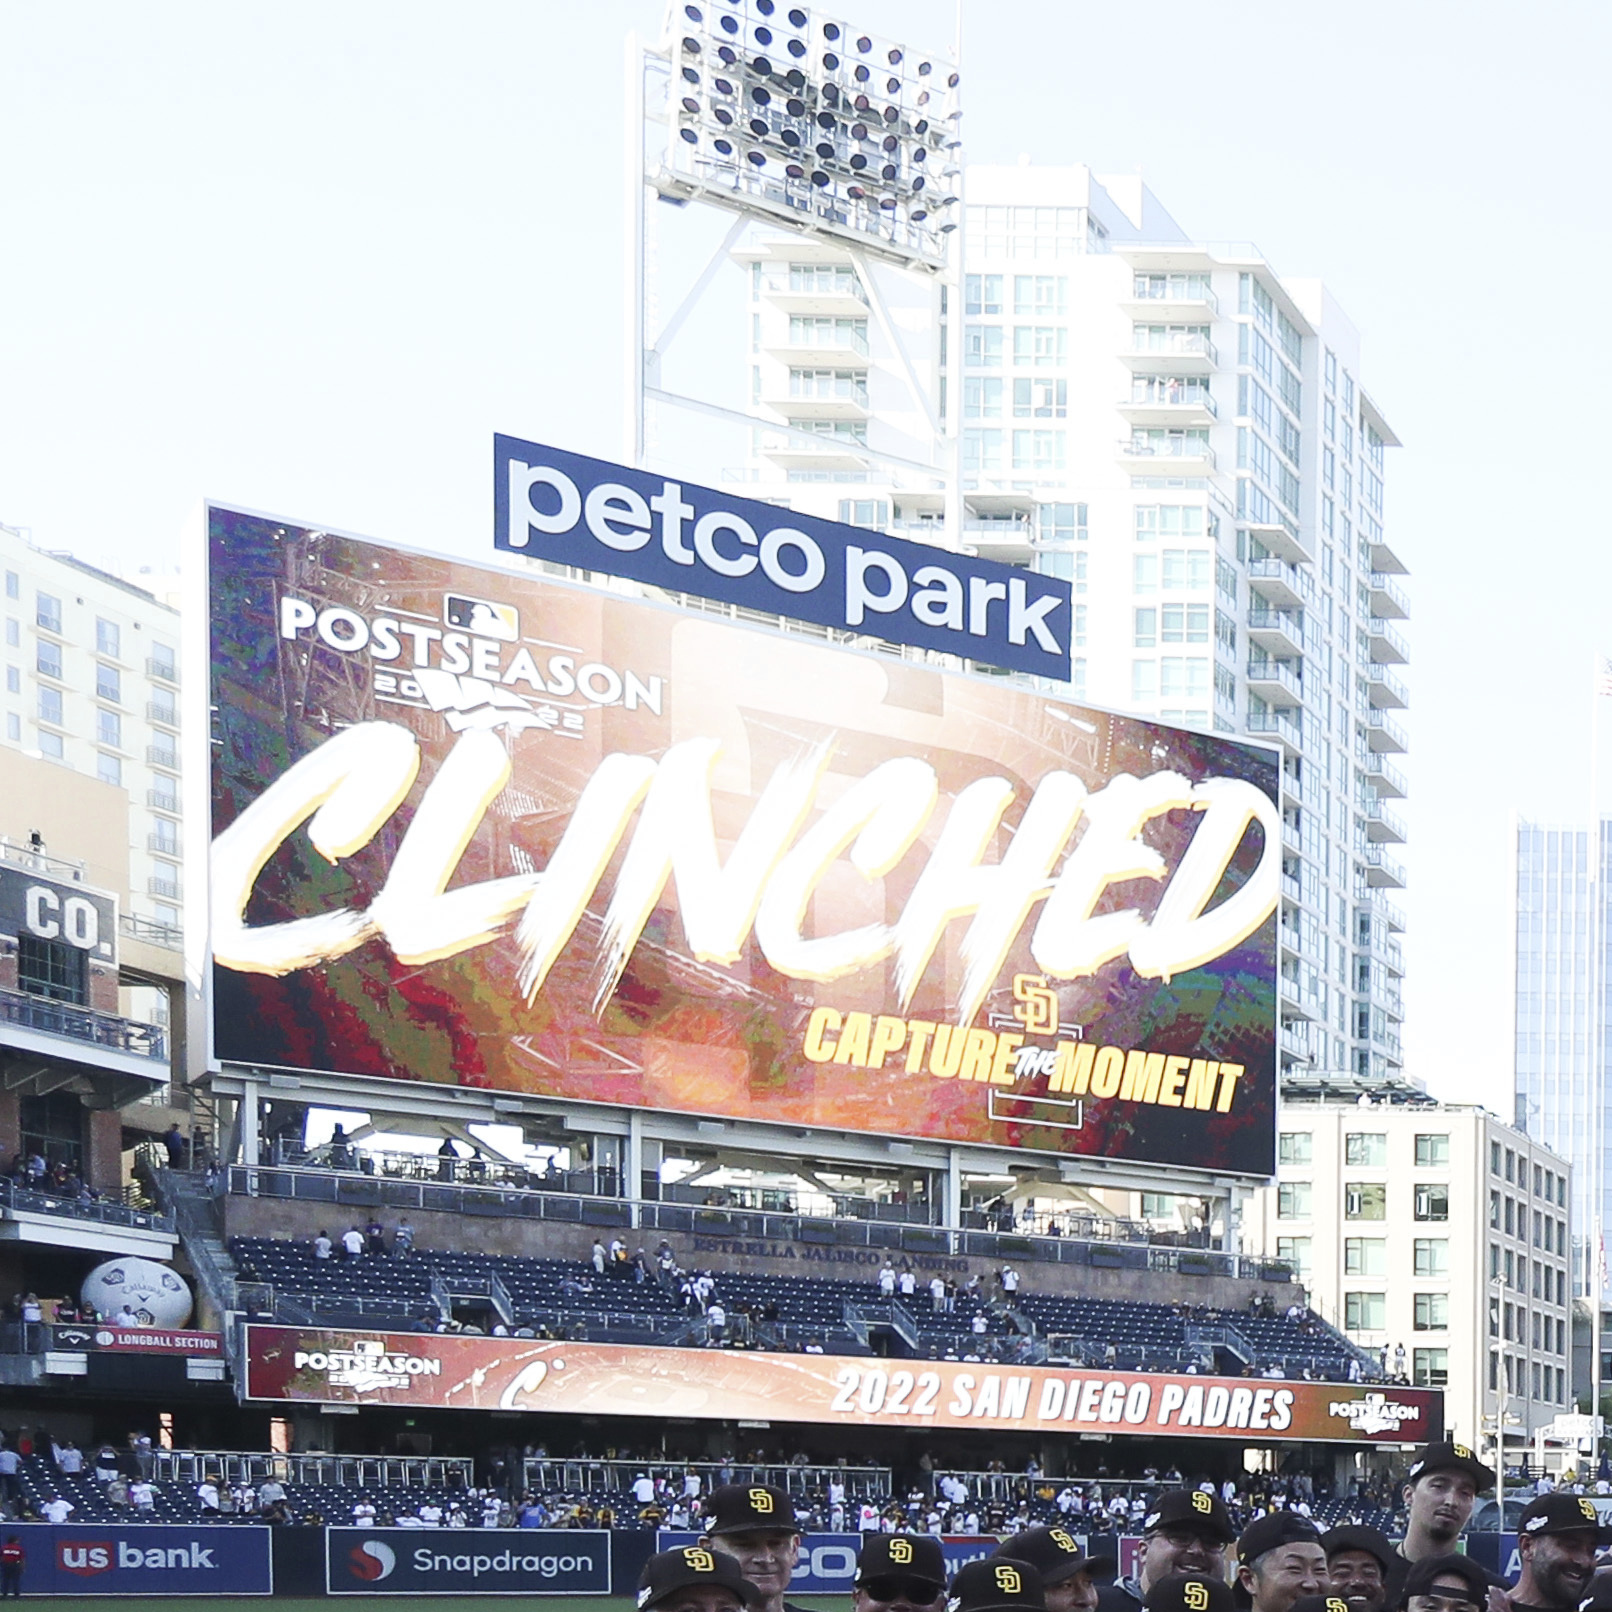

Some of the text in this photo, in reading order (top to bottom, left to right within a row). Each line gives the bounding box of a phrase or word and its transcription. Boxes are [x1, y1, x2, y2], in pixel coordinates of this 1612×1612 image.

[508, 458, 1063, 655] petco park
[280, 596, 662, 716] POSTSEASON
[212, 722, 1281, 1019] CLINCHED
[26, 885, 112, 957] CO.
[1013, 974, 1058, 1036] SD
[804, 1008, 1245, 1113] CAPTURE THE MOMENT
[118, 1334, 172, 1348] LONGBALL
[174, 1337, 218, 1350] SECTION
[294, 1352, 442, 1377] POSTSEASON
[829, 1370, 1295, 1431] 2022 SAN DIEGO PADRES
[1328, 1402, 1420, 1422] POSTSEASON
[62, 1542, 216, 1570] us bank
[413, 1549, 593, 1577] Snapdragon
